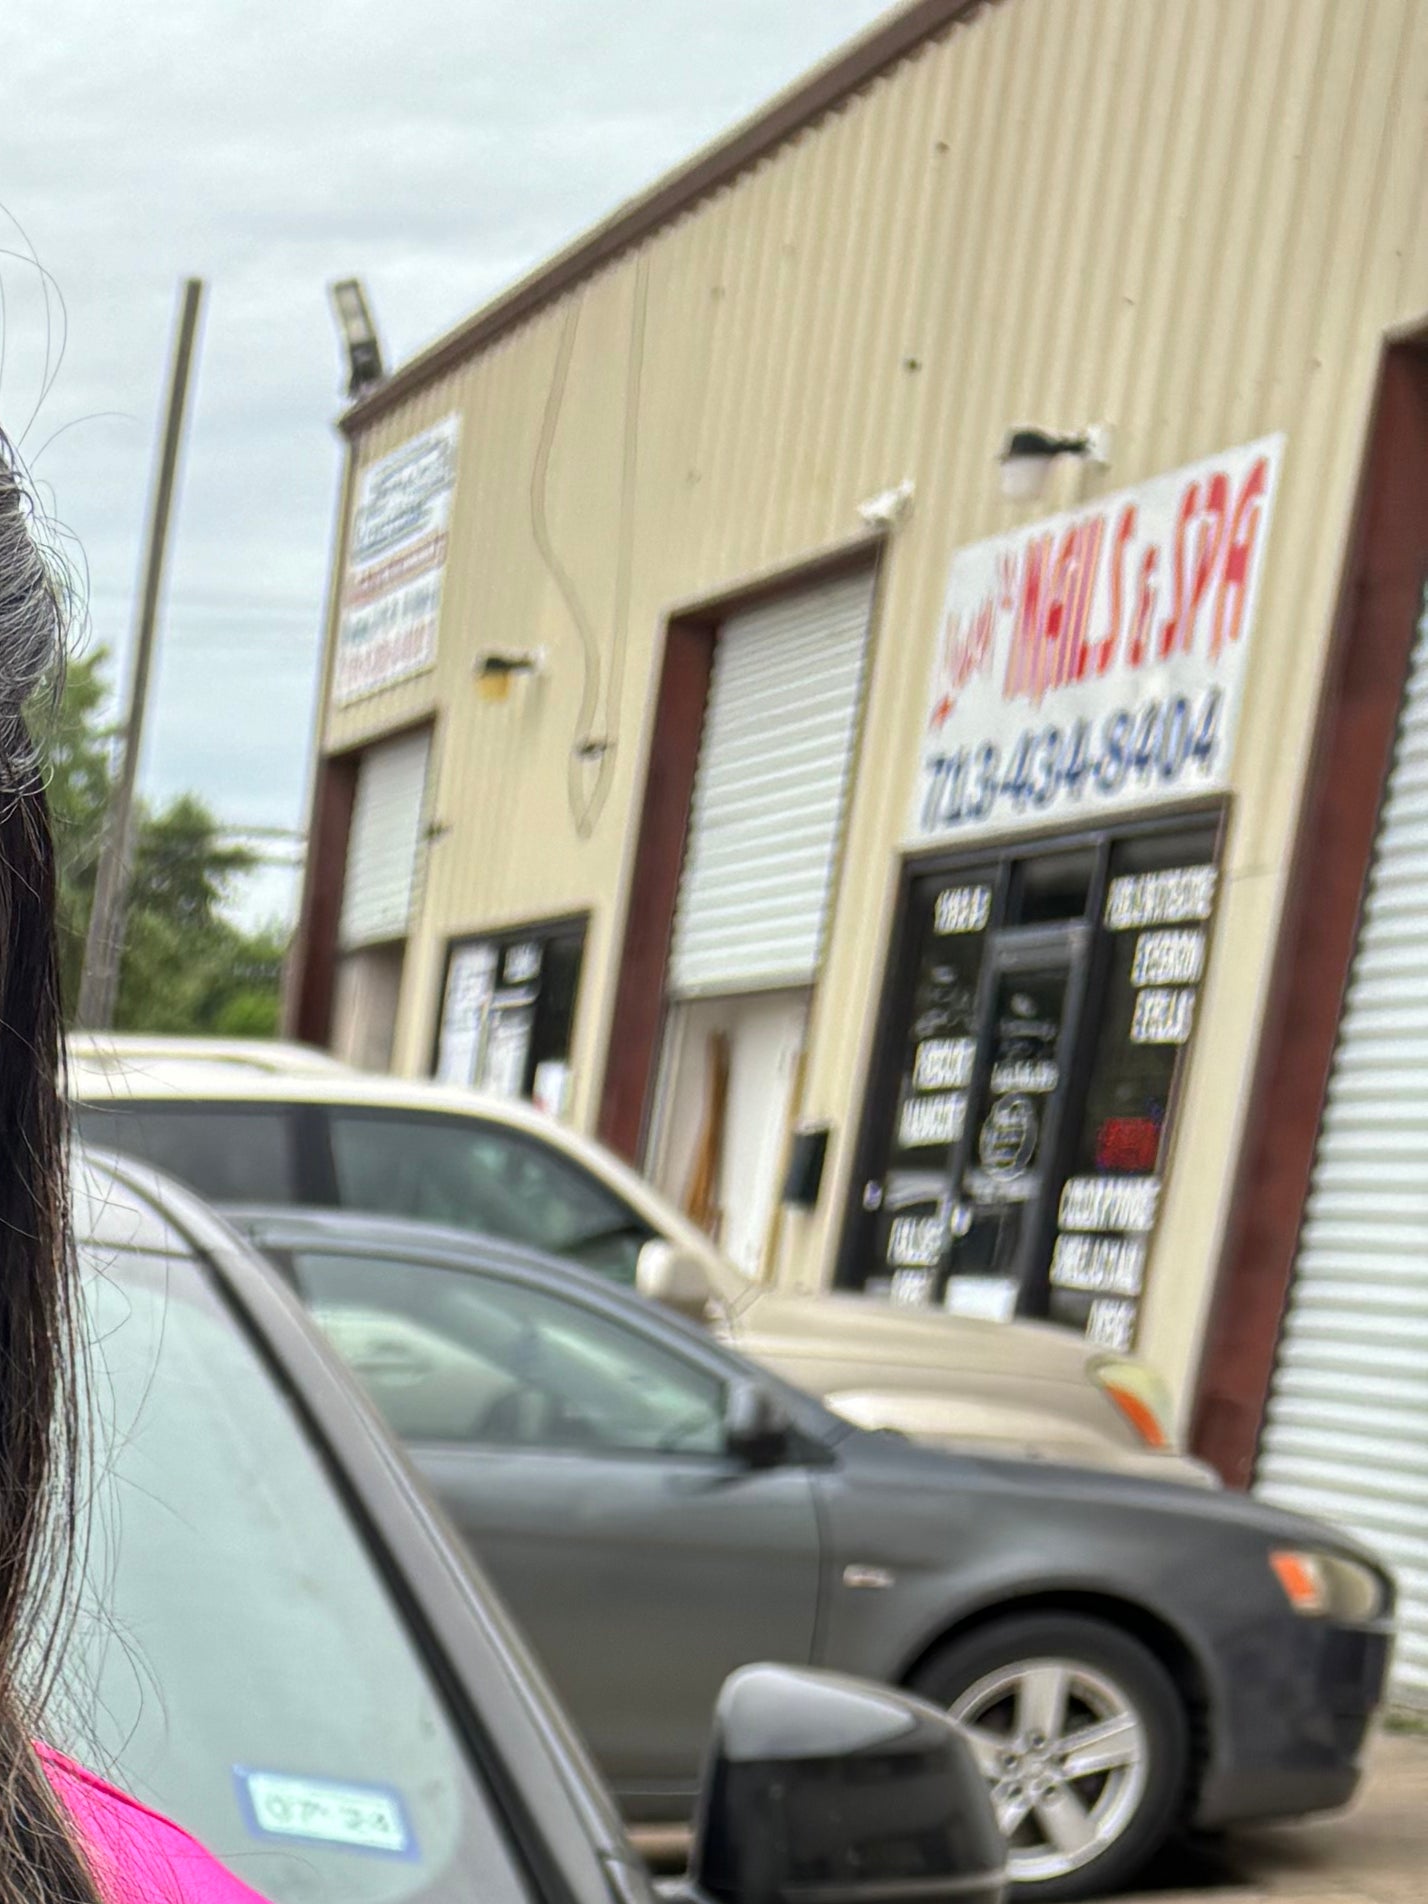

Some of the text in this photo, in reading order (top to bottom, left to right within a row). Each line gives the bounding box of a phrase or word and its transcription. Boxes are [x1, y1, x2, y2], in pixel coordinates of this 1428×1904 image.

[1005, 505, 1135, 708] NAILS
[1158, 456, 1267, 664] SPA
[921, 686, 1223, 833] 713-434-8404
